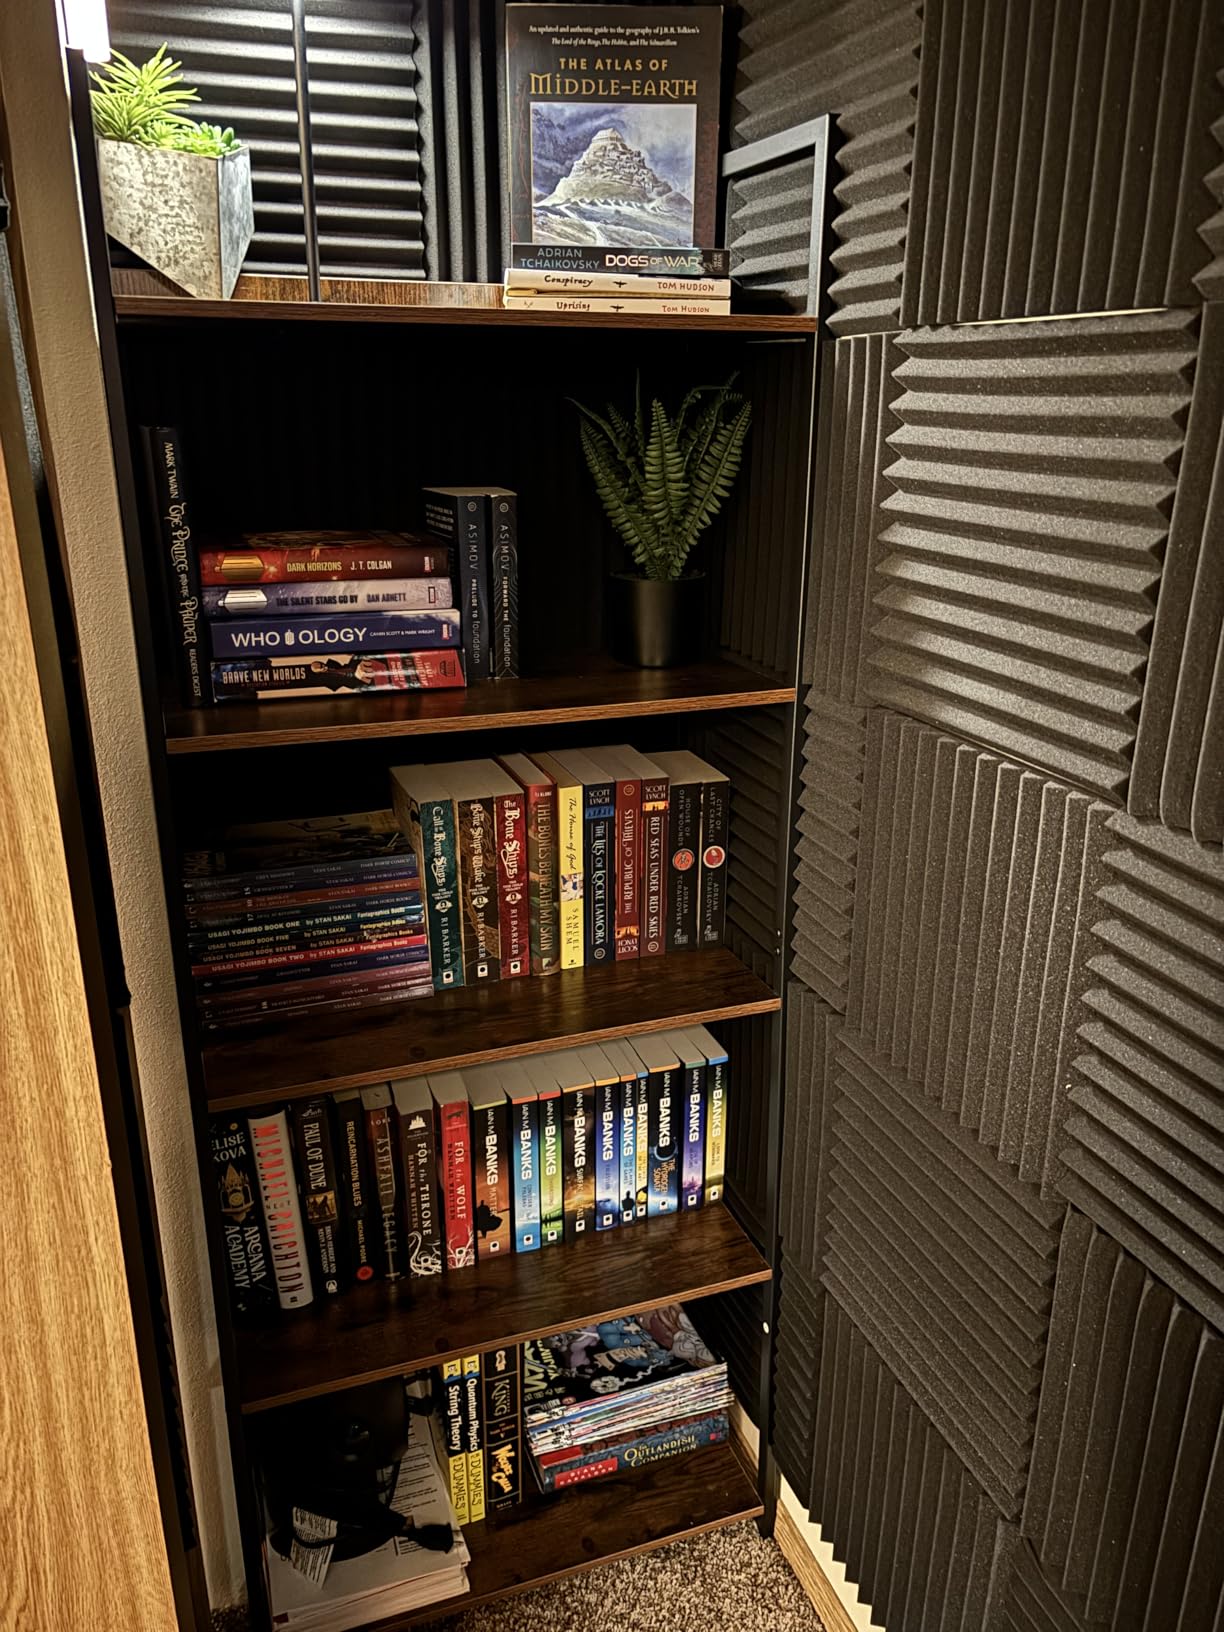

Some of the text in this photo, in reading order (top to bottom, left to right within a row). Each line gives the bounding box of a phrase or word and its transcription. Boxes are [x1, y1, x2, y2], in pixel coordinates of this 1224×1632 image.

[560, 58, 668, 71] THE ATLAS OF
[520, 259, 600, 270] TCHAIKOVSKY
[537, 248, 582, 258] ADRIAN
[605, 254, 648, 267] DOGS
[650, 257, 663, 267] OF
[664, 257, 699, 269] WAR
[544, 275, 593, 288] Conspiracy
[657, 281, 714, 295] TOM HUDSON
[163, 442, 180, 499] MARK TWAIN
[468, 523, 478, 570] ASIMOV
[500, 524, 510, 570] ASIMOV
[287, 561, 343, 572] DARK HORIZONS
[367, 560, 392, 570] COLGAN
[231, 626, 367, 648] WHO OLOGY
[472, 620, 481, 664] foundation
[503, 624, 512, 667] foundation
[222, 669, 249, 685] BRAVE
[252, 668, 275, 683] NEW
[277, 666, 306, 682] WORLDS
[590, 788, 610, 798] SCOTT
[645, 784, 667, 793] SCOTT
[432, 806, 445, 826] Call
[538, 803, 552, 822] THE
[650, 816, 661, 834] RED
[708, 786, 718, 843] LAST CHANCES
[716, 798, 724, 818] CITY
[433, 832, 447, 857] Bone
[470, 803, 487, 883] Bone Wake
[500, 807, 521, 879] Bone Ships
[538, 825, 552, 859] BONES
[565, 797, 577, 871] The House of God
[678, 812, 686, 846] WOUNDS
[621, 809, 635, 914] THE REPUBLIC THIEVES
[650, 838, 661, 859] SEAS
[431, 856, 448, 887] Ships
[539, 861, 553, 905] BENEATH
[649, 862, 661, 891] UNDER
[591, 839, 607, 945] LIES LOCKE LAMORA
[649, 895, 660, 913] RED
[676, 875, 684, 925] TCHAIKOVSKY
[706, 871, 714, 921] TCHAIKOVSKY
[712, 882, 720, 911] ADRIAN
[208, 929, 231, 938] USAGI
[264, 923, 286, 931] BOOK
[286, 920, 301, 929] ONE
[315, 915, 333, 924] STAN
[333, 914, 352, 922] SAKAI
[328, 926, 347, 934] SAKAI
[540, 908, 553, 923] MY
[565, 915, 573, 946] SHEM
[571, 907, 580, 952] SAMUEL
[649, 915, 660, 939] SKIES
[289, 953, 305, 961] TWO
[318, 948, 336, 957] STAN
[336, 945, 356, 954] SAKAI
[441, 929, 452, 965] BARKER
[477, 924, 487, 960] BARKER
[510, 920, 520, 956] BARKER
[540, 926, 553, 951] SKIN
[692, 1069, 700, 1083] IAIN
[546, 1100, 554, 1115] IAIN
[689, 1093, 701, 1142] BANKS
[712, 1065, 723, 1137] IAIN BANKS
[304, 1122, 320, 1147] PAUL
[574, 1091, 586, 1167] IAIN BANKS
[602, 1086, 614, 1160] IAIN BANKS
[623, 1082, 635, 1156] IAIN BANKS
[637, 1103, 649, 1150] BANKS
[658, 1097, 671, 1147] BANKS
[306, 1147, 323, 1161] OF
[485, 1109, 498, 1185] IAIN BANKS
[520, 1104, 532, 1180] IAIN BANKS
[544, 1125, 557, 1176] BANKS
[253, 1124, 289, 1200] MICHAEL
[308, 1161, 327, 1189] DUNE
[347, 1121, 363, 1207] REINCARNATION BLUES
[376, 1138, 398, 1252] ASHFALL LEGACY
[415, 1142, 433, 1236] FOR THRONE
[454, 1141, 468, 1219] FOR WOLF
[653, 1168, 661, 1192] SONATA
[489, 1185, 497, 1217] MATTER
[357, 1220, 365, 1245] MICHAEL
[224, 1225, 251, 1288] ACADEMY
[242, 1225, 267, 1281] ARCANA
[267, 1210, 305, 1294] CRICHTON
[466, 1378, 482, 1452] Quantum Physics
[491, 1379, 510, 1417] KING
[447, 1385, 464, 1451] String Theory
[624, 1434, 696, 1461] OUTLANDISH
[630, 1443, 697, 1467] COMPANION
[453, 1460, 466, 1510] DUMMIES
[471, 1459, 482, 1507] DUMMIES
